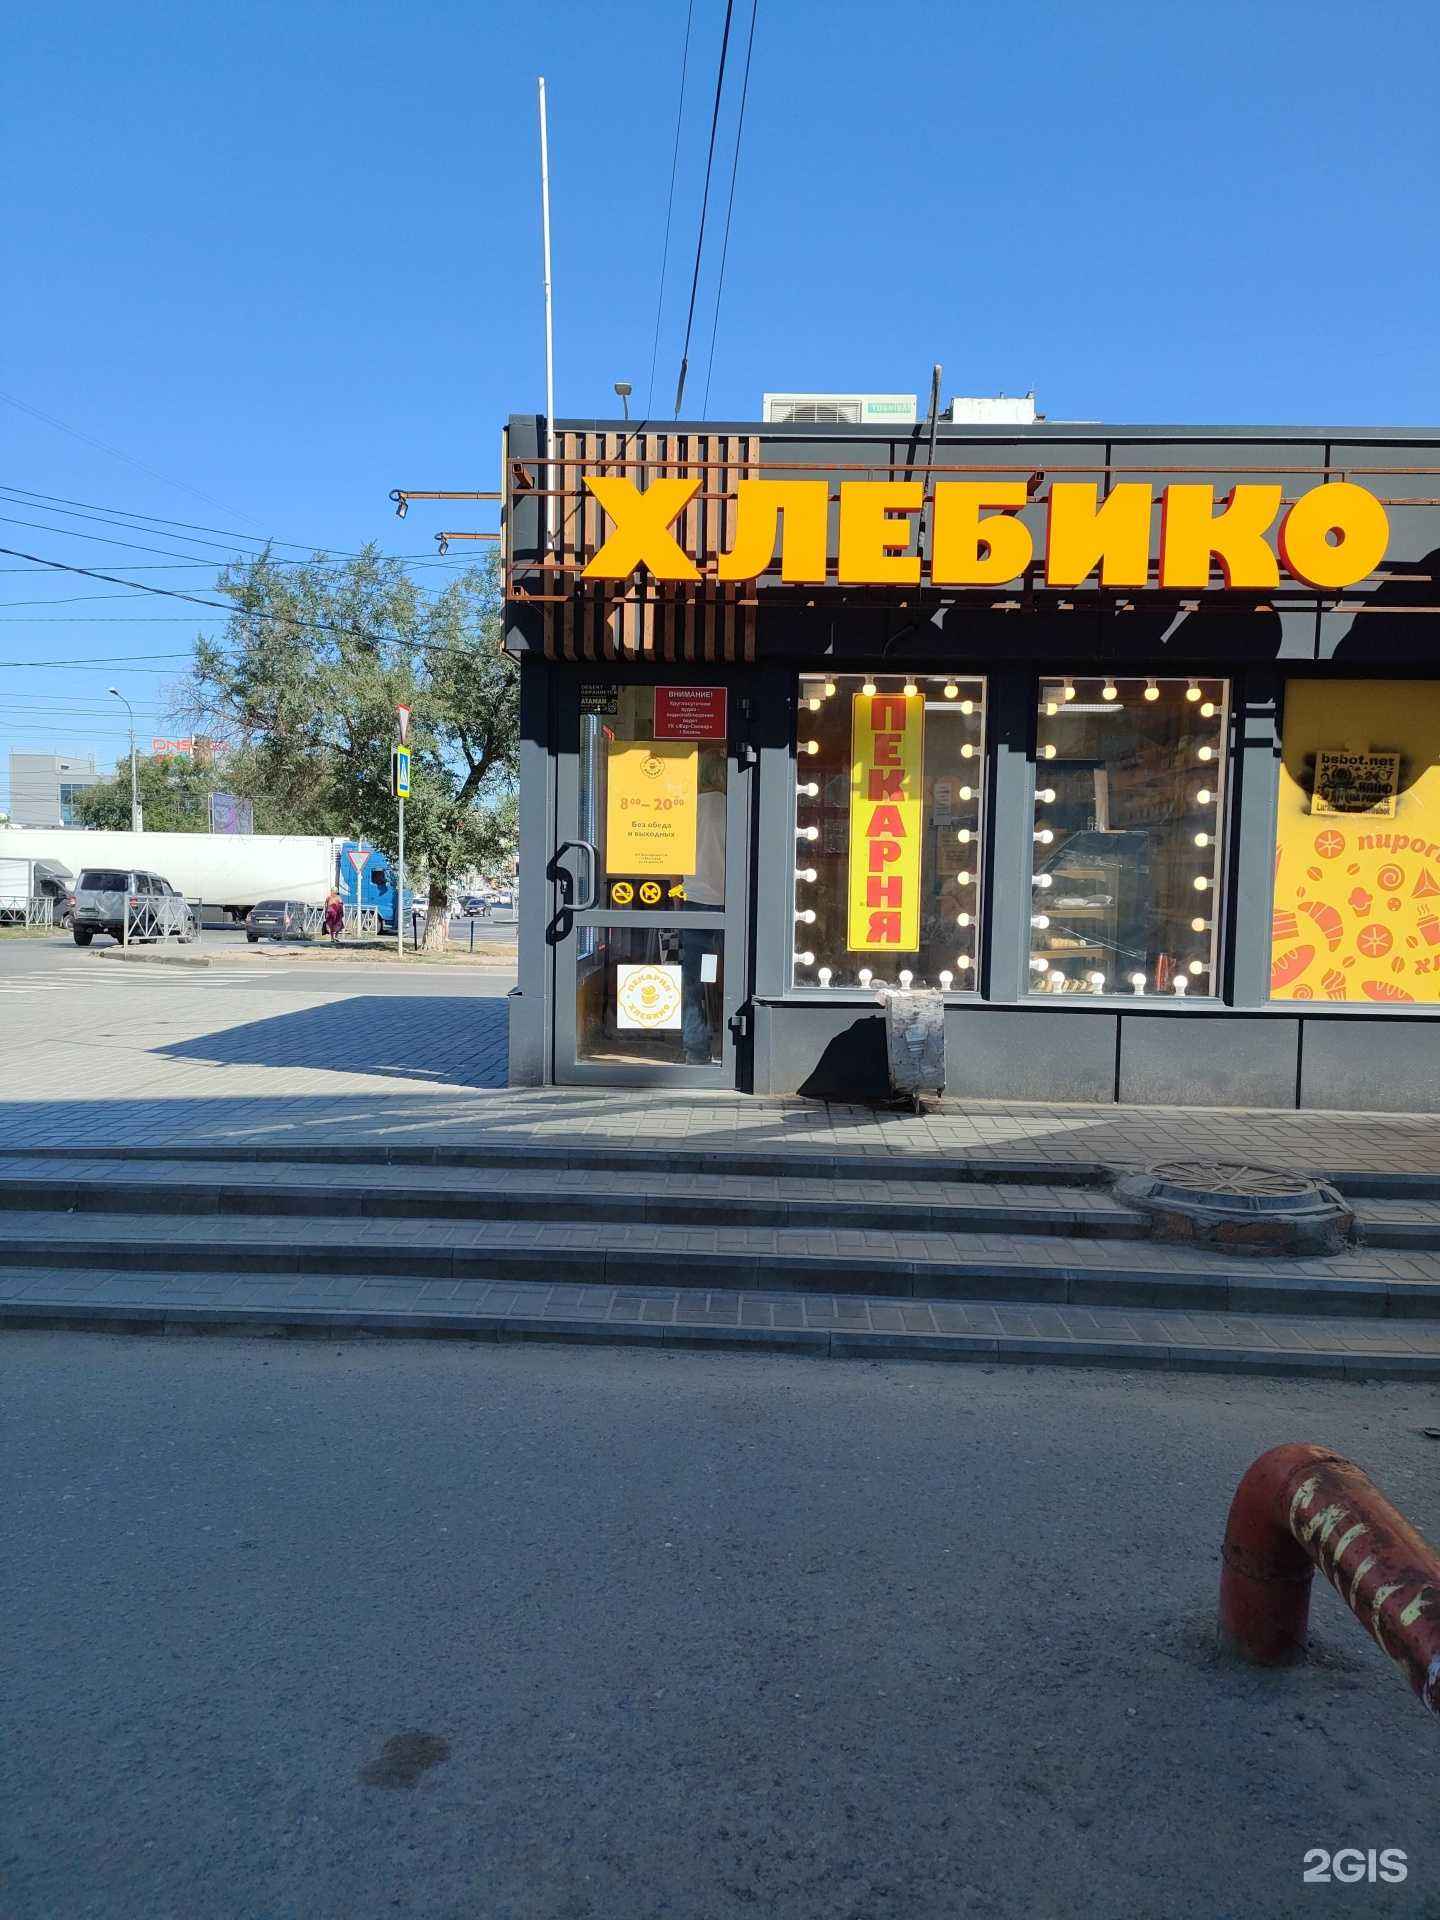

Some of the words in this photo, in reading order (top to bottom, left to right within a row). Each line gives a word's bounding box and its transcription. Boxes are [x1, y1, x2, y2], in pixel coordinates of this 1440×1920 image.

[583, 476, 1389, 590] ХЛЕБИКО
[1321, 752, 1395, 766] bsbot.net
[648, 821, 672, 829] обеда
[865, 697, 907, 943] ПЕКАРНЯ
